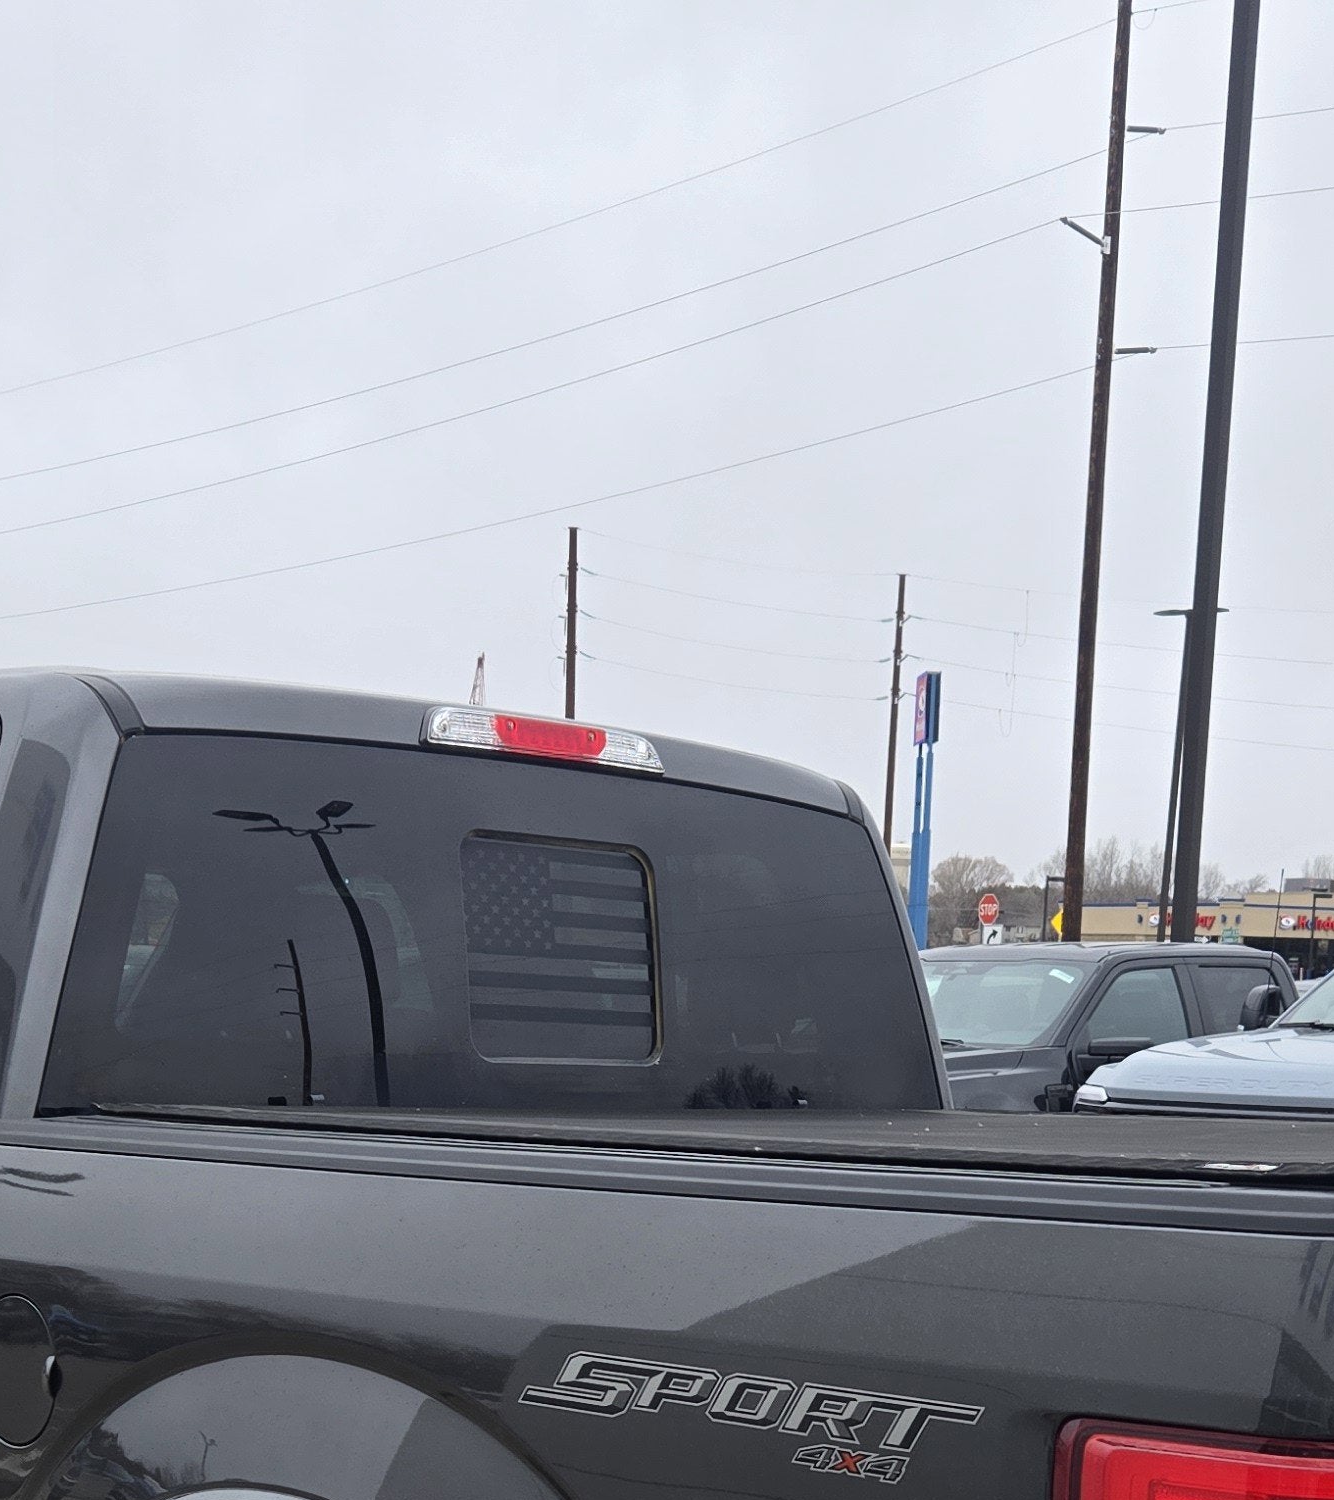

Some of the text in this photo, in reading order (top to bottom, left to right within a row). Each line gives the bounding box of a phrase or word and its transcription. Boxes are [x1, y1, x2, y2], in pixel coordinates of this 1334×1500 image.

[980, 903, 998, 916] STOP
[1134, 1073, 1334, 1091] SUPER DUTY
[518, 1350, 986, 1452] SPORT
